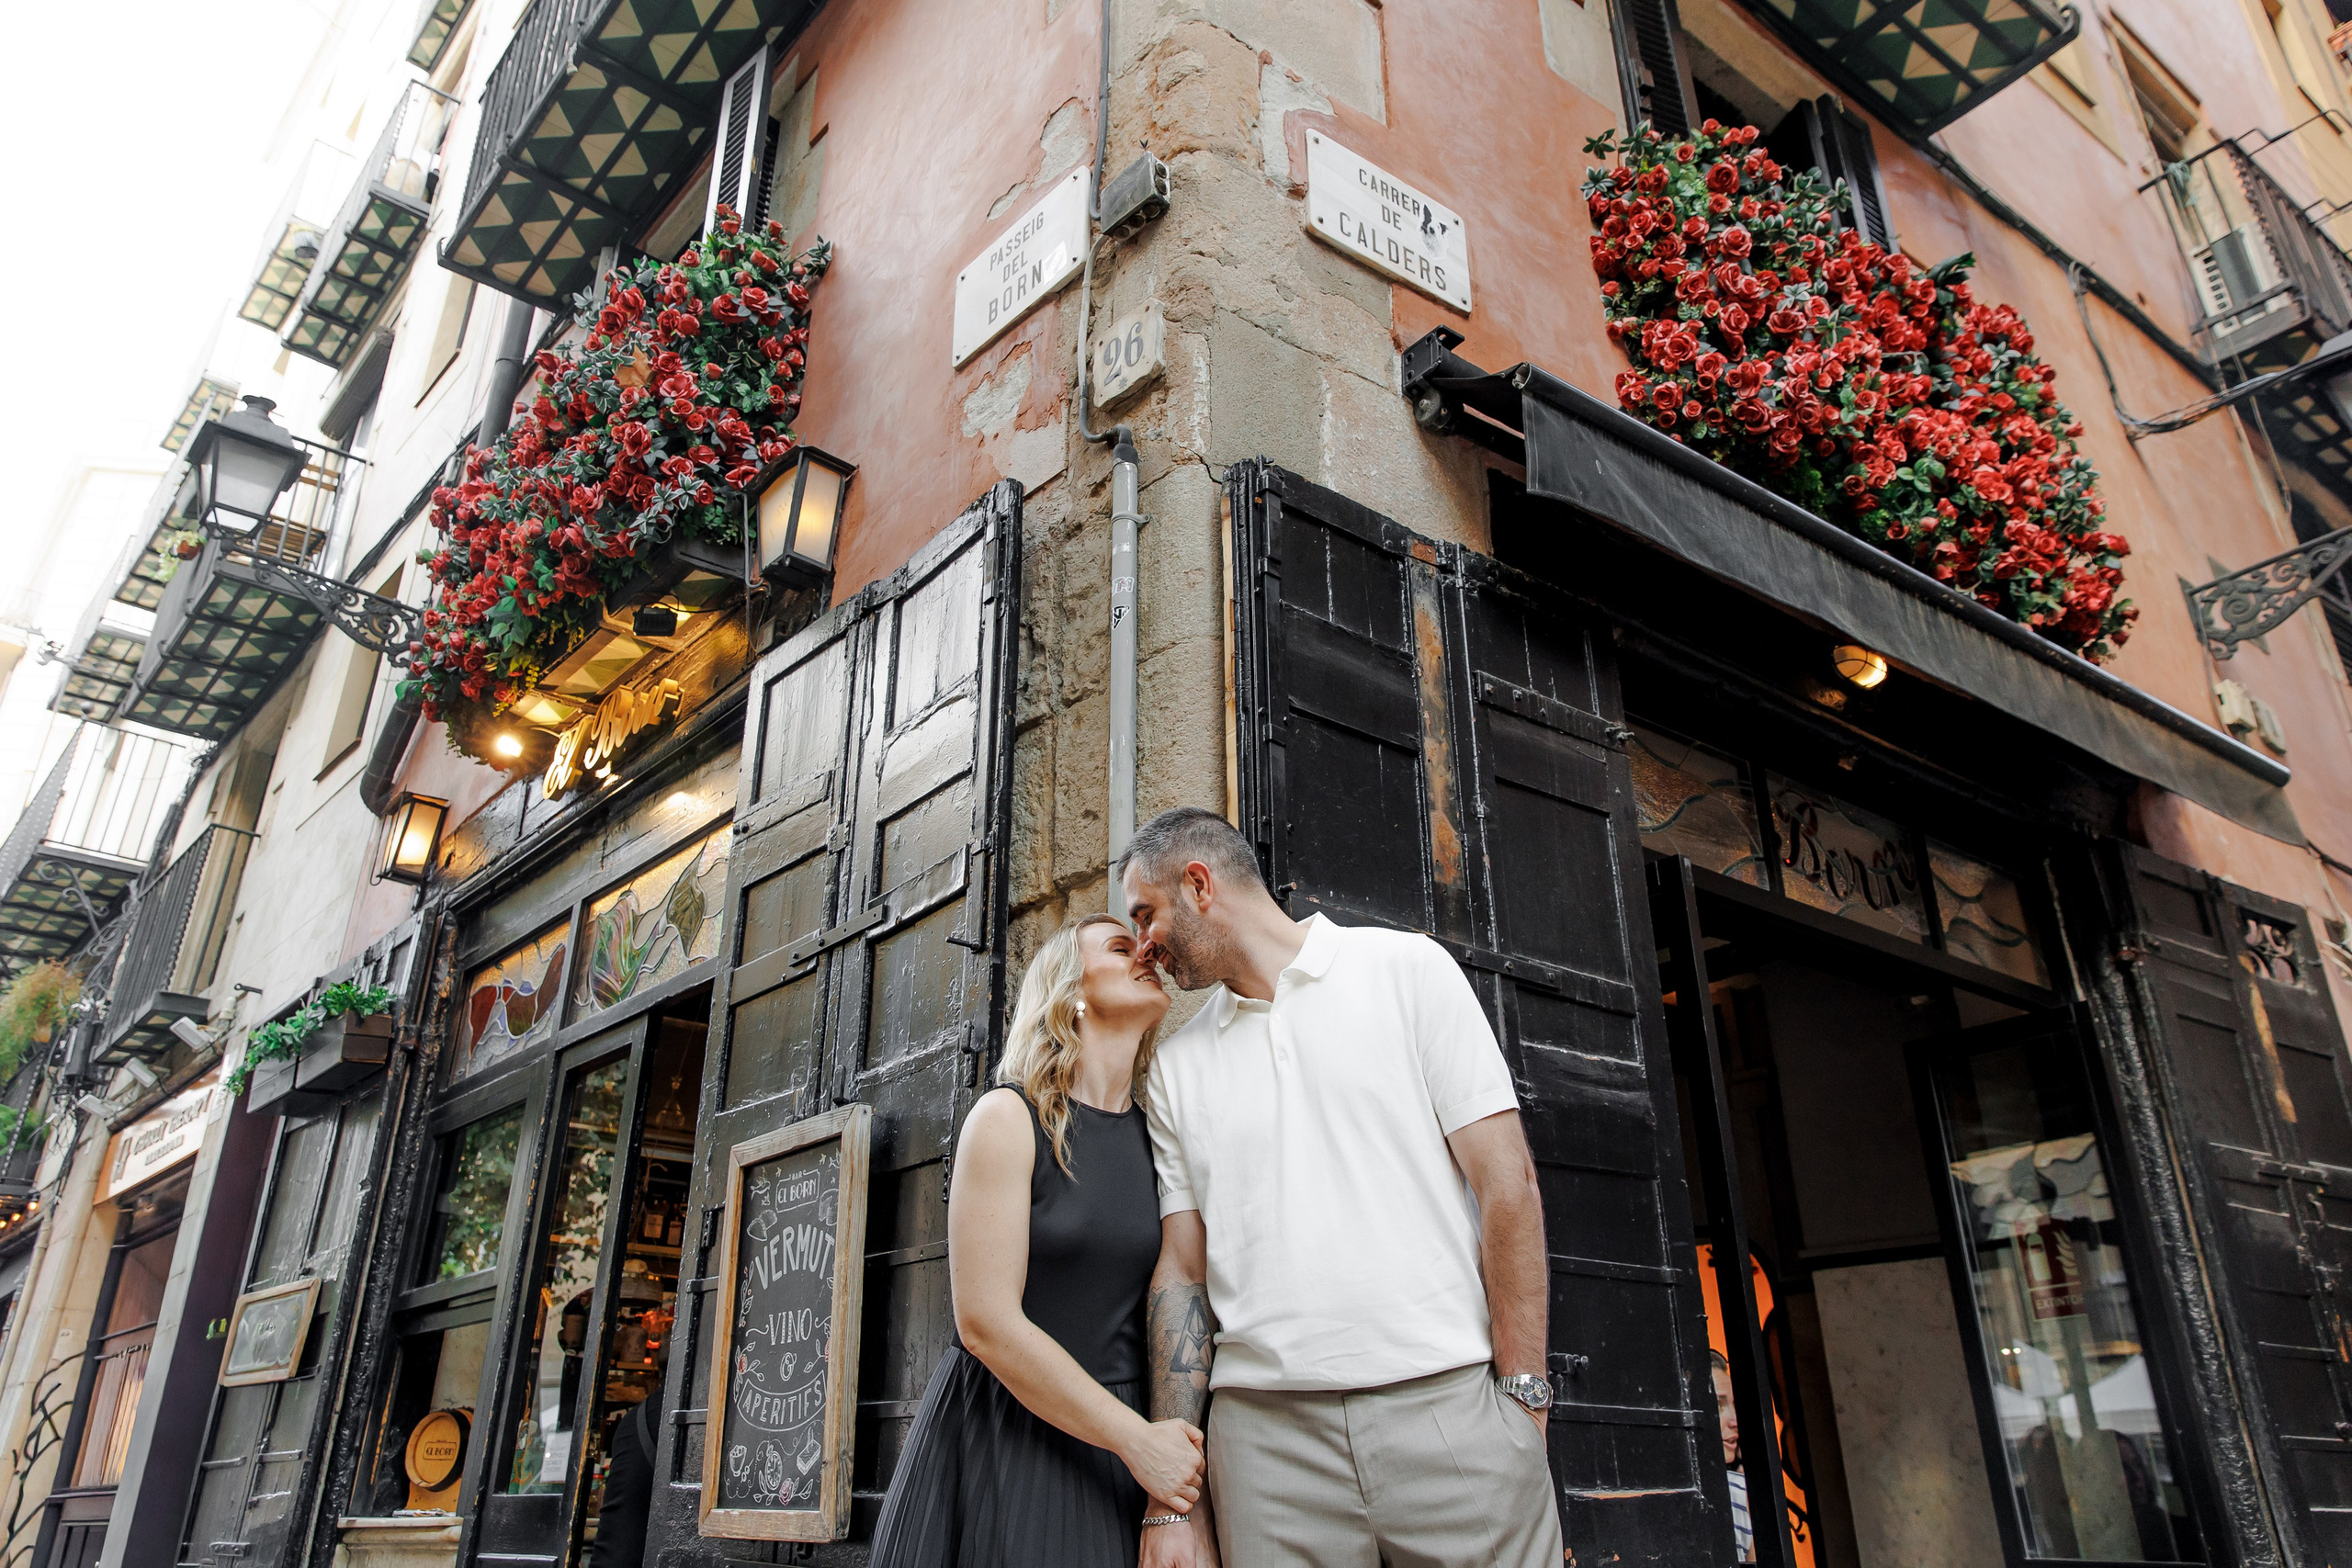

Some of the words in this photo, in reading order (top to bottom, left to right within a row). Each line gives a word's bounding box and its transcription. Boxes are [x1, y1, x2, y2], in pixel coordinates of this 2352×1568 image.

[1359, 168, 1420, 218] CARRER
[1381, 204, 1402, 231] DE
[989, 211, 1044, 272] PASSEIG
[1340, 211, 1447, 291] CALDERS
[988, 259, 1043, 325] BORN
[1002, 250, 1028, 284] DEL
[1103, 321, 1144, 387] 26
[790, 1179, 817, 1201] BORN
[755, 1223, 835, 1291] VERMUT
[769, 1307, 813, 1346] VINO
[742, 1380, 822, 1425] APERITIFS
